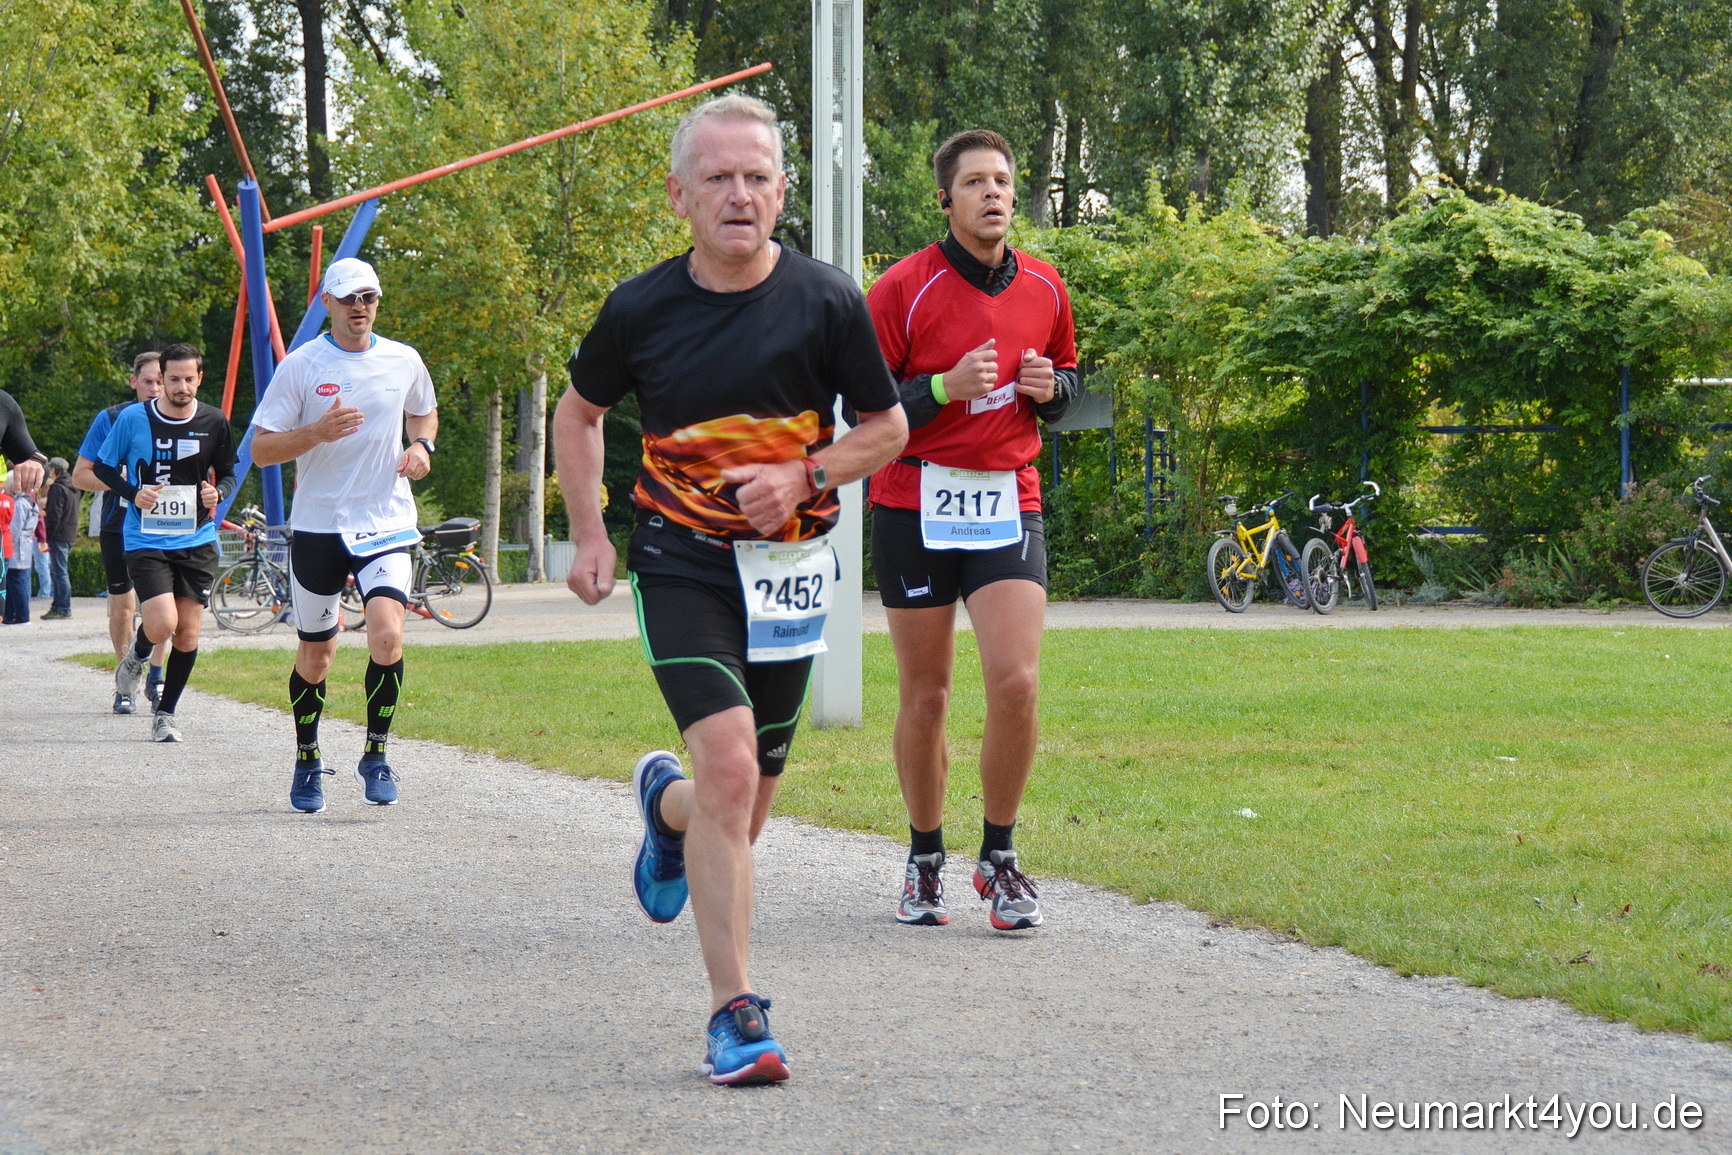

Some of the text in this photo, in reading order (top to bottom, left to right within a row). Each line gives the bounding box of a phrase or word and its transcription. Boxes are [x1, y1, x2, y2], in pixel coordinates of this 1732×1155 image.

[150, 500, 186, 516] 2191
[935, 489, 1002, 517] 2117
[156, 519, 182, 527] Christian
[950, 526, 991, 536] Andreas
[371, 535, 397, 547] Werner
[754, 573, 823, 613] 2452
[772, 623, 810, 639] Raimund
